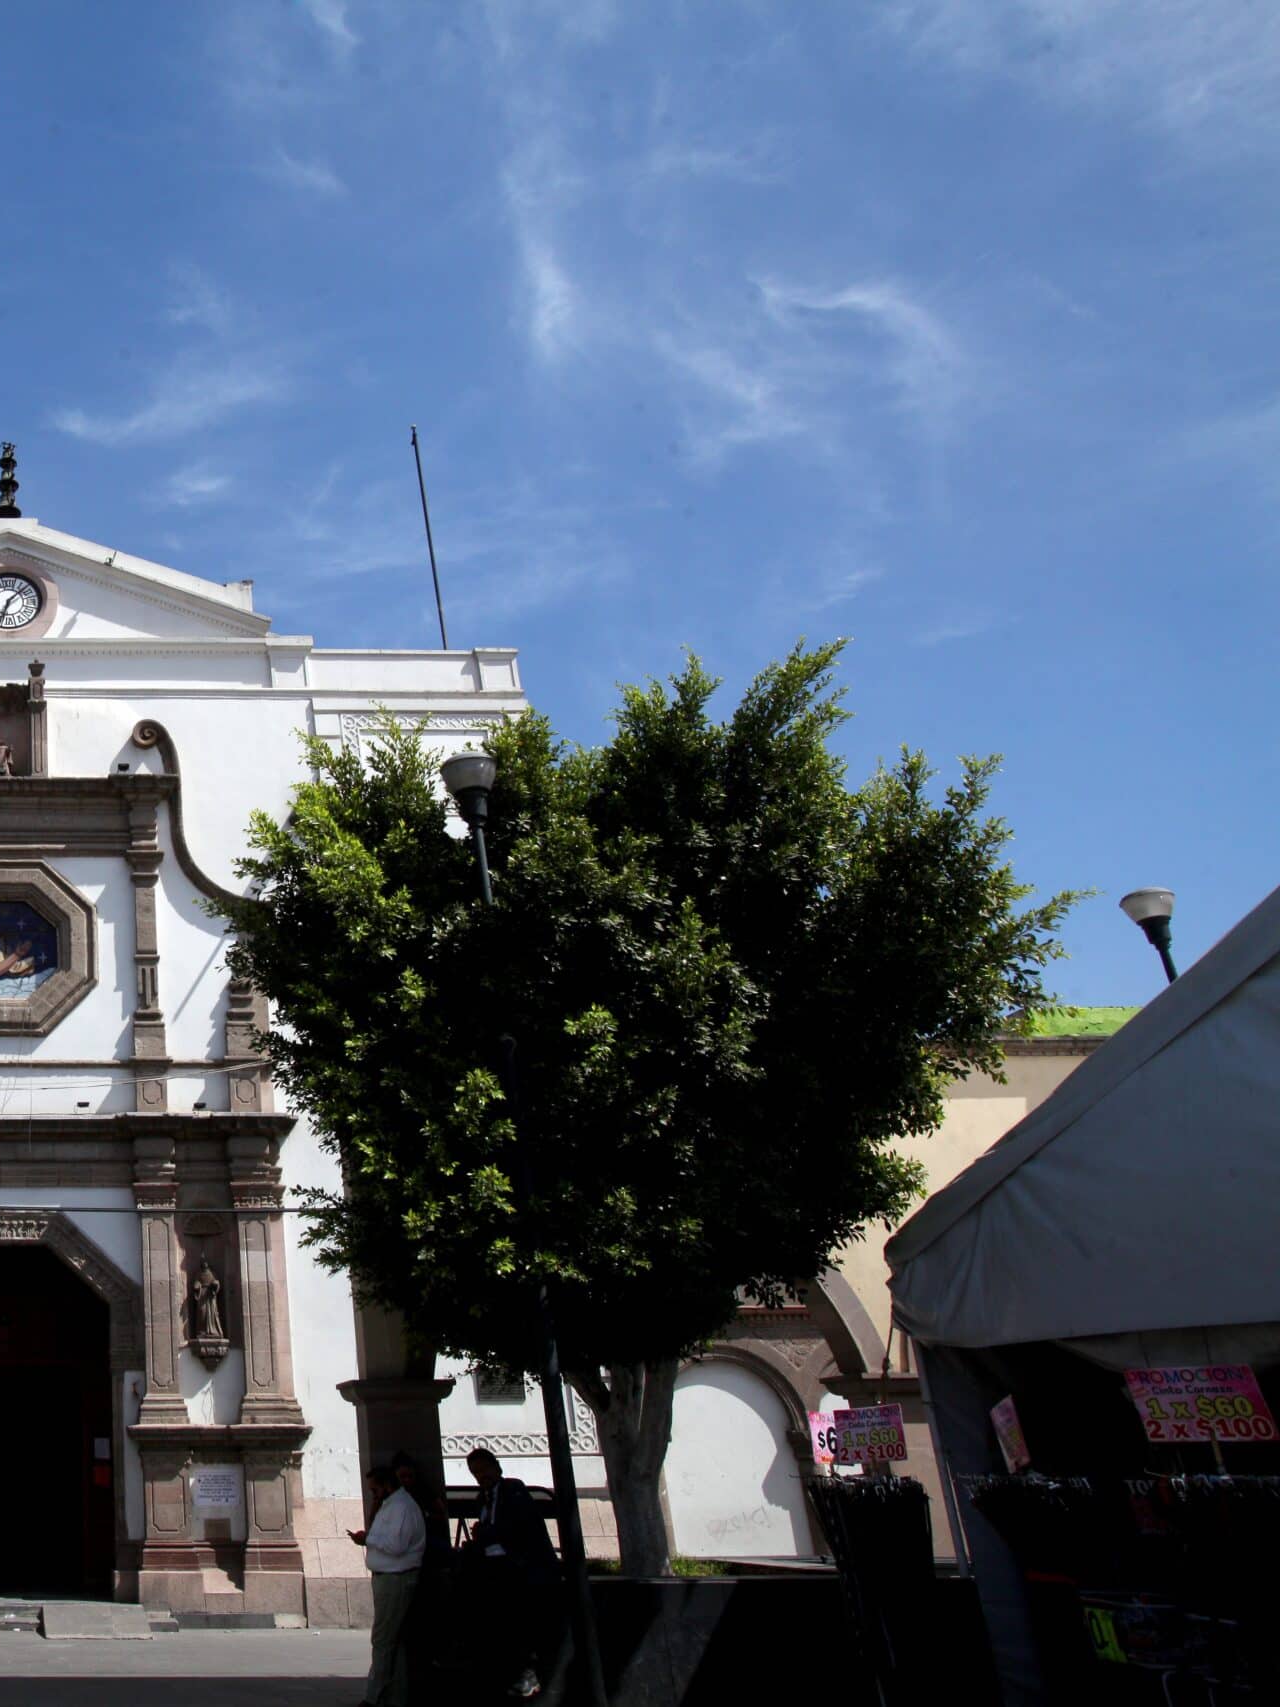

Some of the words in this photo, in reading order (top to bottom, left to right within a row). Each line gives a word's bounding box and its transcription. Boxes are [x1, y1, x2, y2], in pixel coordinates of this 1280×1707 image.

[1146, 1397, 1169, 1419] 1
[1170, 1401, 1195, 1419] x
[1196, 1394, 1255, 1418] $60
[842, 1430, 854, 1447] 1
[855, 1433, 867, 1446] x
[869, 1427, 899, 1445] $60
[1146, 1420, 1166, 1438] 2
[1172, 1423, 1191, 1438] x
[1196, 1417, 1272, 1438] $100
[840, 1447, 849, 1461] 2
[854, 1449, 863, 1460] x
[867, 1443, 905, 1459] $100
